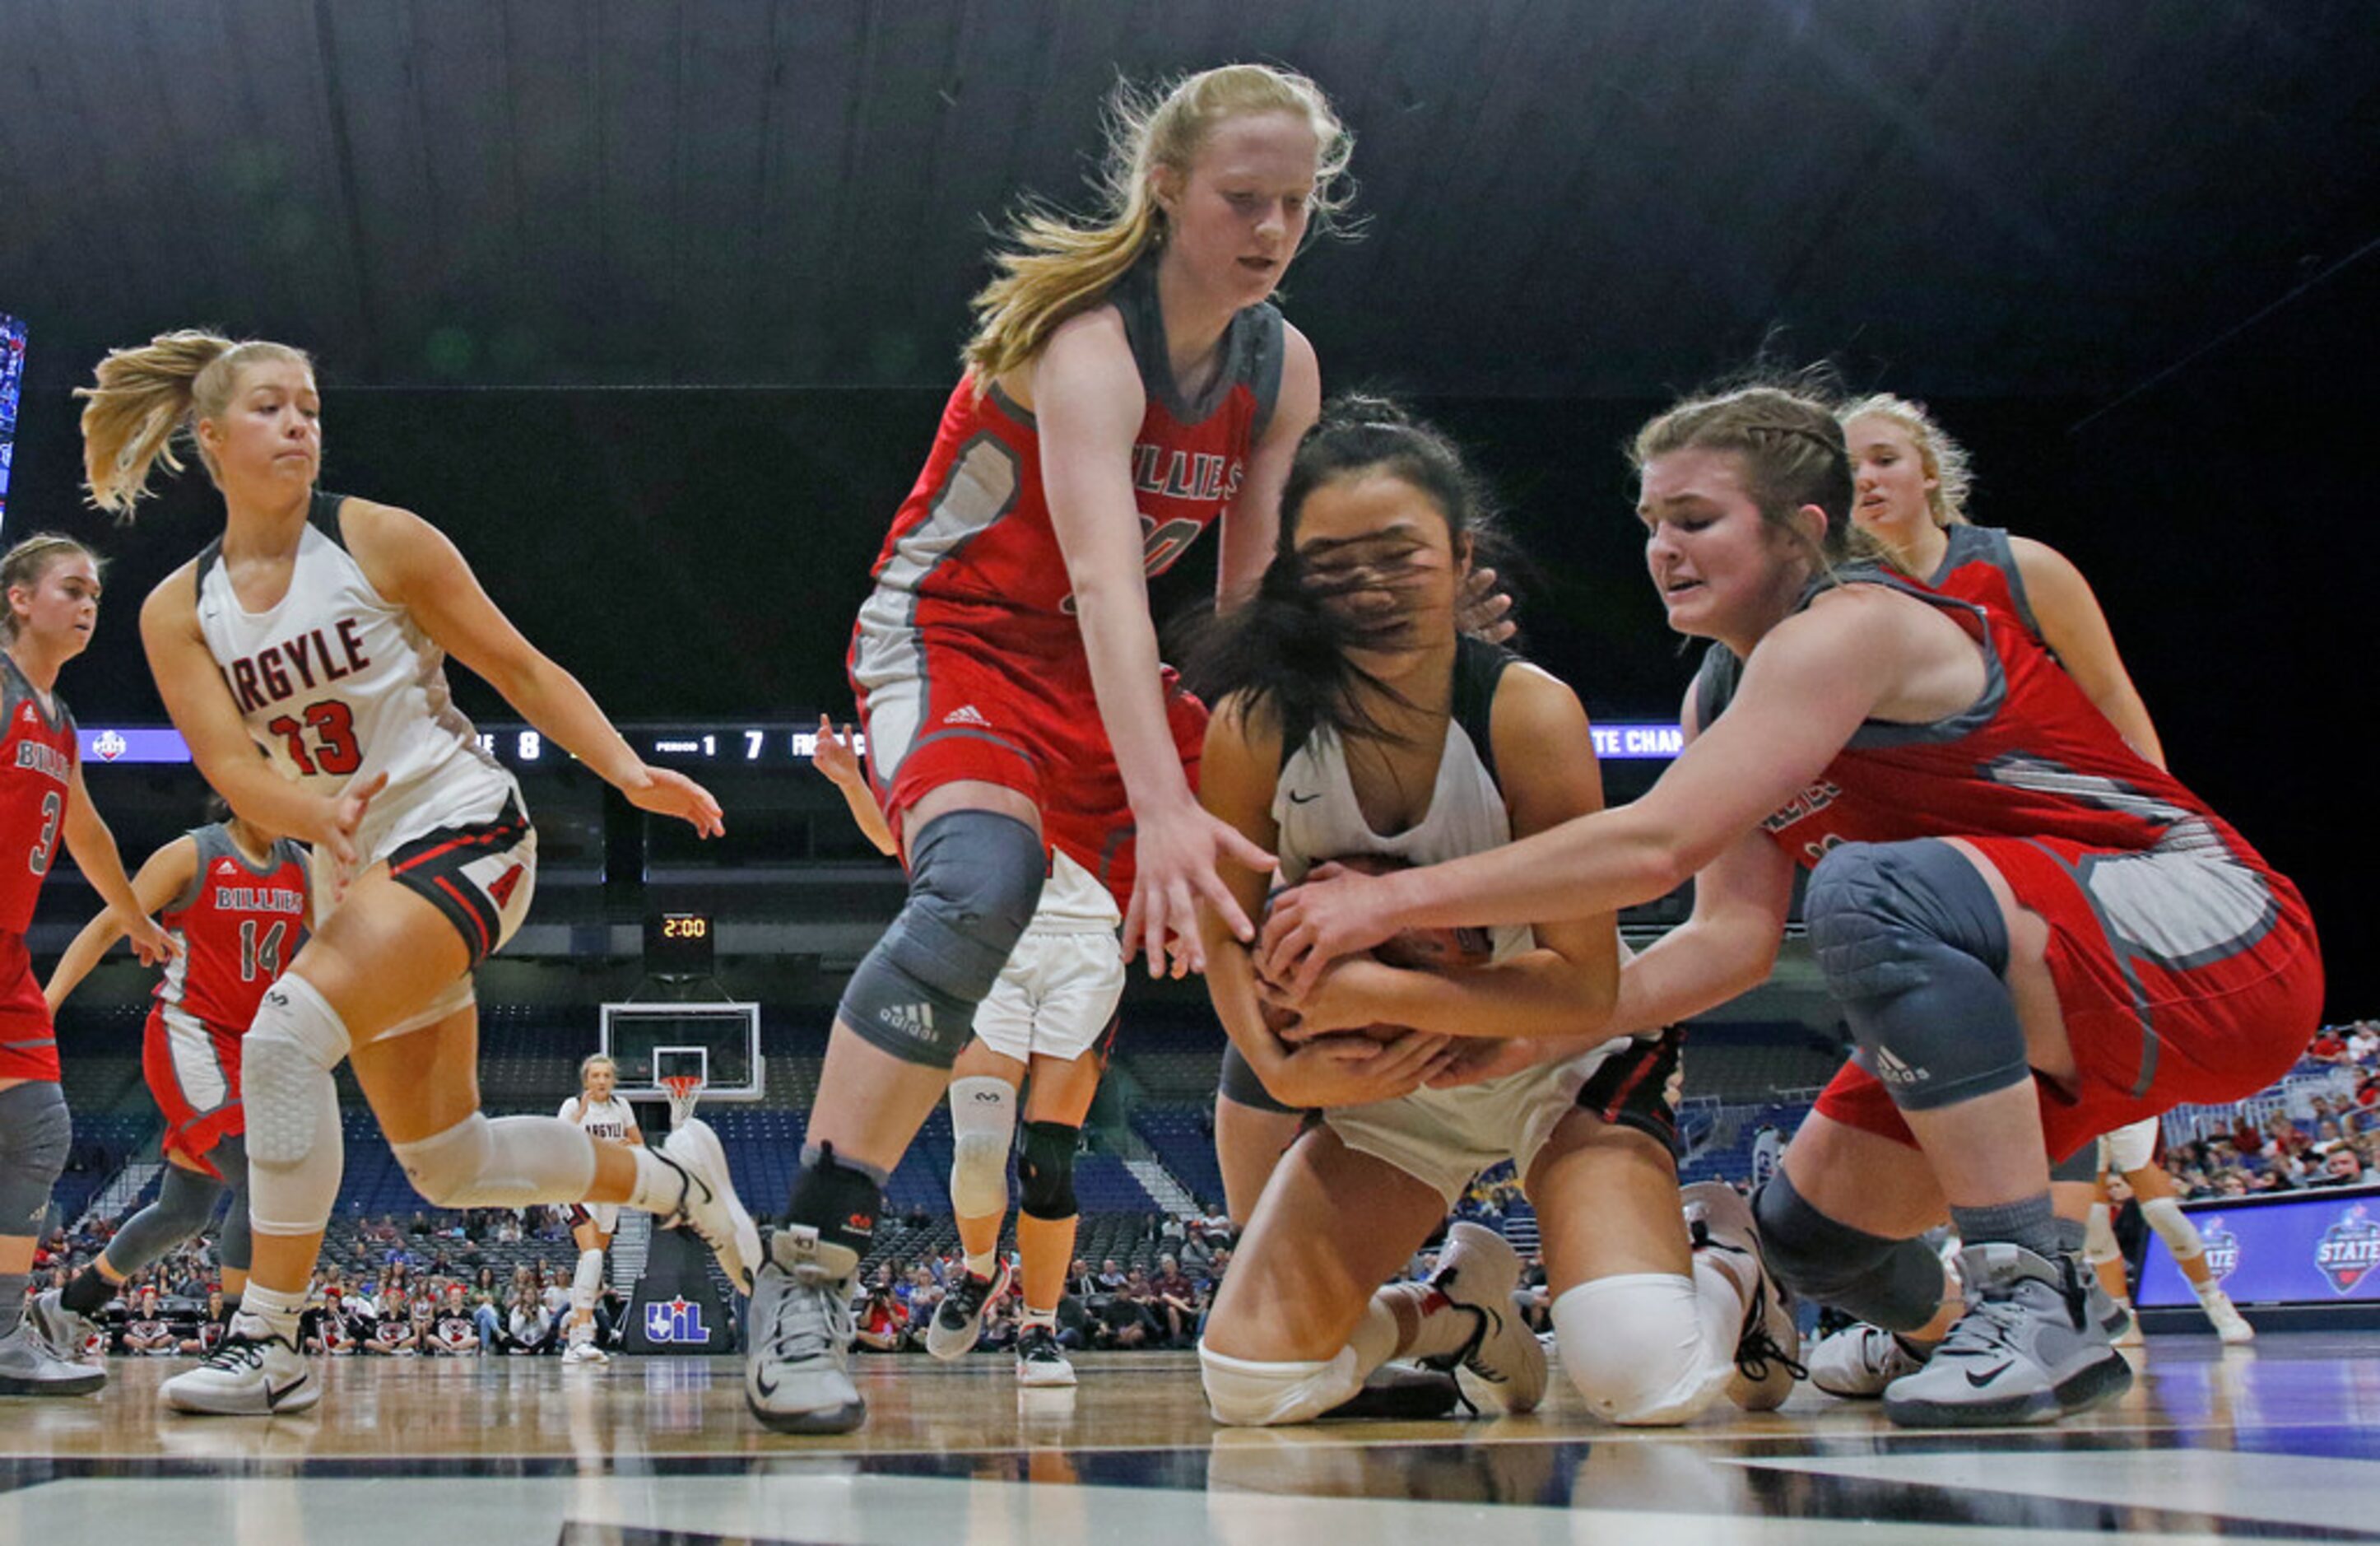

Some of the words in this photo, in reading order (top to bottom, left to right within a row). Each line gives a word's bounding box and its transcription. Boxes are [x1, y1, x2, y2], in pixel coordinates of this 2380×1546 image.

[268, 698, 363, 775] 13
[518, 731, 540, 761] 8
[703, 735, 716, 757] 1
[745, 729, 764, 759] 7
[28, 790, 61, 876] 3
[216, 886, 304, 915] BILLIES
[663, 918, 705, 938] 2:00
[239, 920, 286, 983] 14
